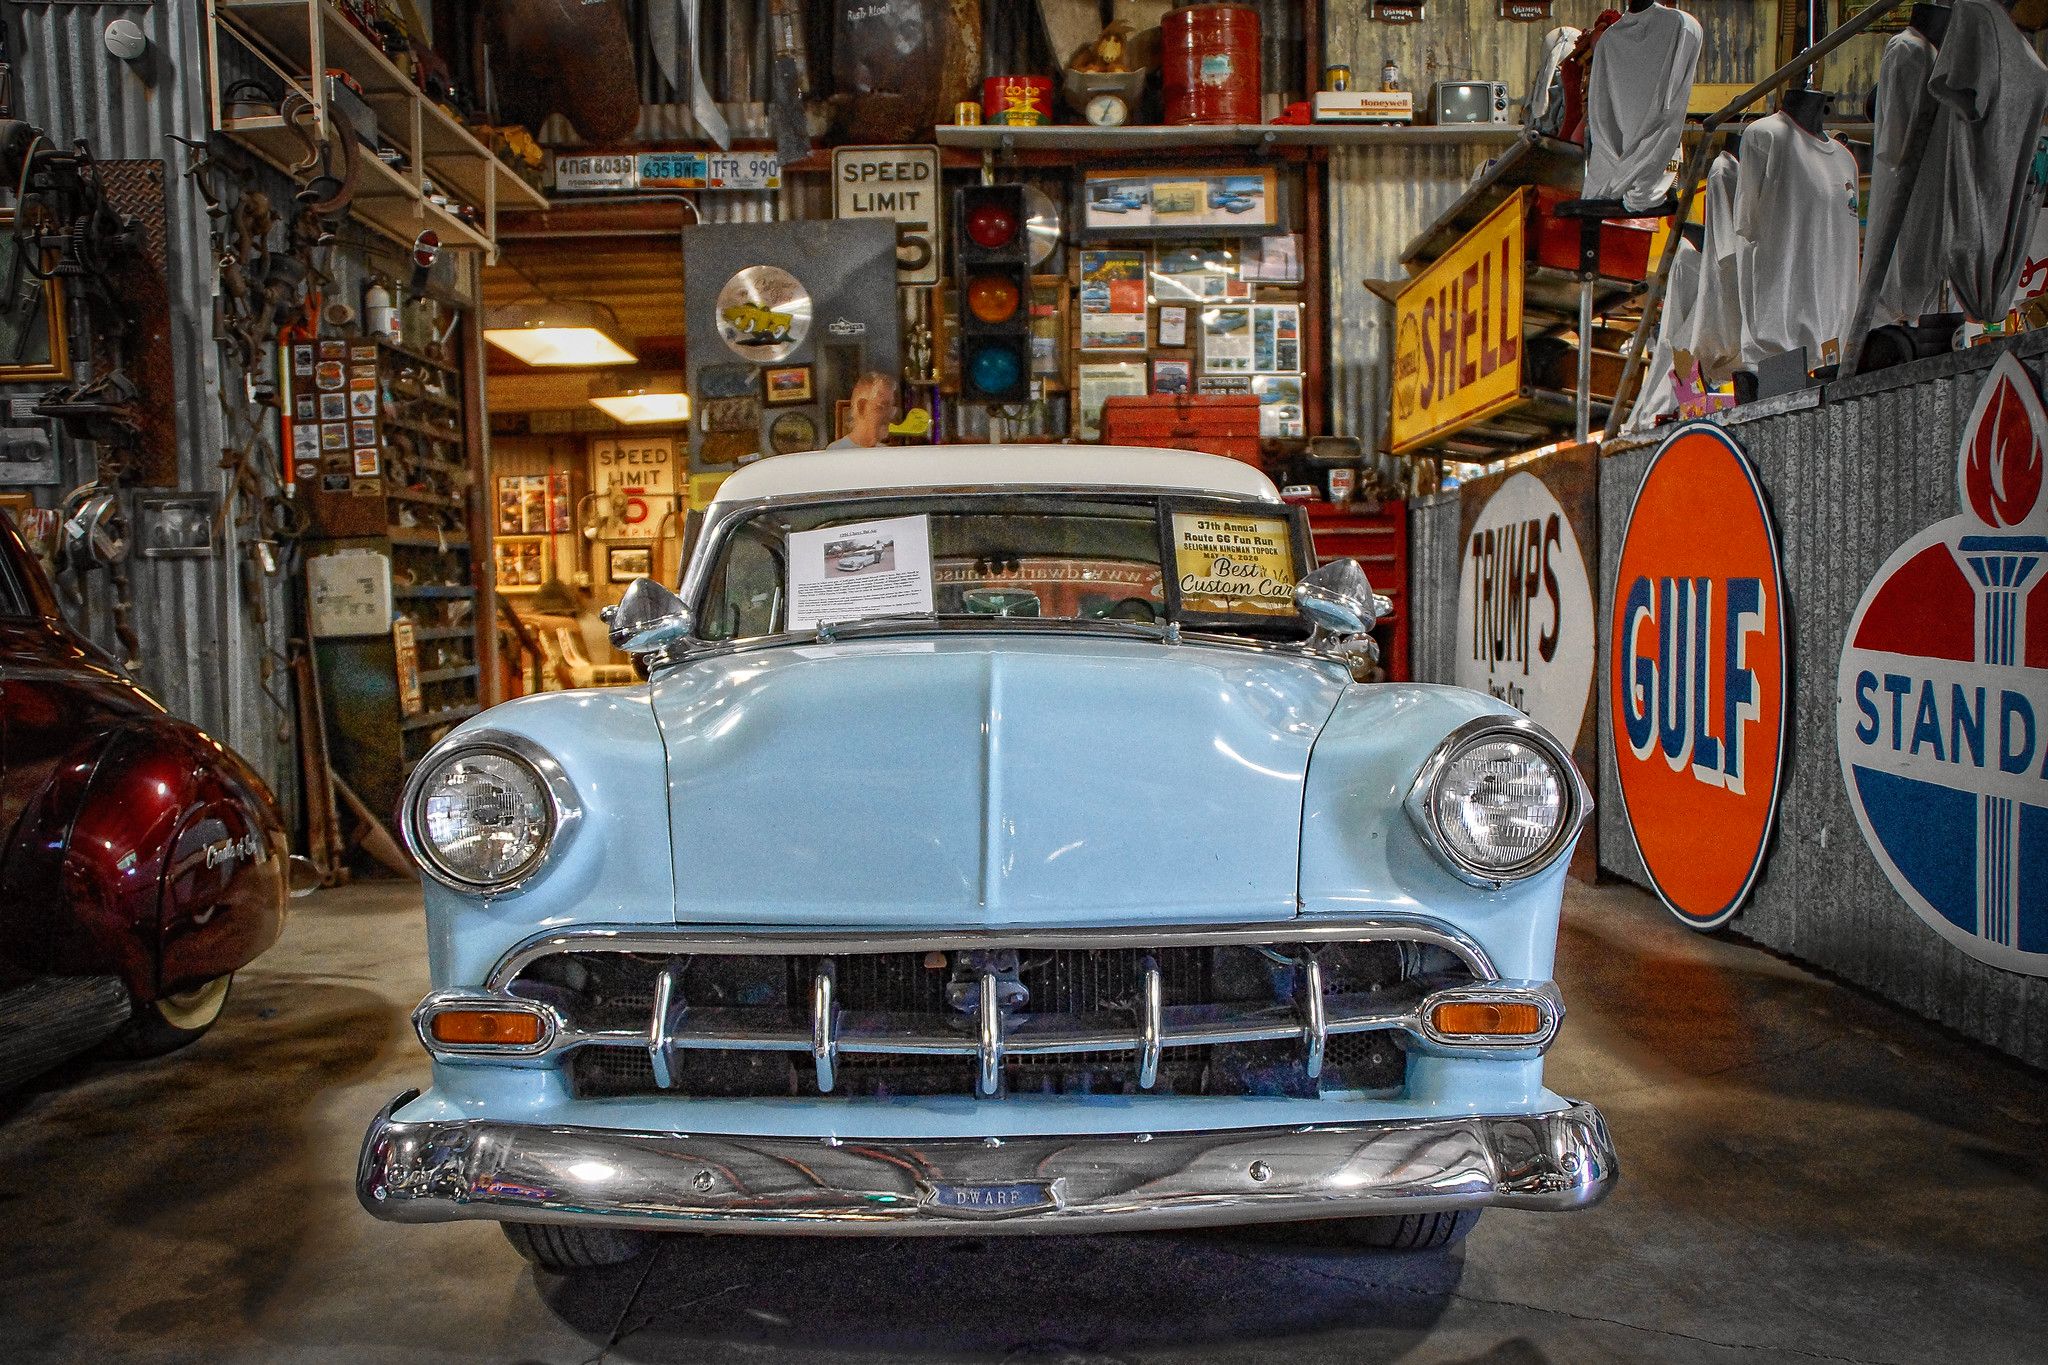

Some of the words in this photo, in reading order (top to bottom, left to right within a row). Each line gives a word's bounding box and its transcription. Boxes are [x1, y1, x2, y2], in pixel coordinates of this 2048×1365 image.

[1005, 86, 1040, 97] CO-OP
[1360, 99, 1408, 108] Honeywell
[643, 160, 670, 179] 635
[749, 160, 777, 178] 990
[843, 161, 930, 182] SPEED
[852, 191, 920, 212] LIMIT
[895, 221, 932, 271] 5
[1420, 235, 1518, 411] SHELL
[600, 448, 668, 466] SPEED
[1197, 521, 1221, 531] 37th
[1223, 522, 1258, 533] Annual
[1184, 532, 1214, 543] Route
[1233, 535, 1252, 545] Fun
[1254, 536, 1274, 546] Run
[1183, 543, 1218, 552] SELIGMAN
[1220, 544, 1251, 554] KINGMAN
[1252, 546, 1279, 556] TOPOCK
[1213, 557, 1259, 578] Best
[1180, 574, 1255, 595] Custom
[1258, 578, 1293, 596] Car
[1472, 511, 1562, 675] TRUMPS
[1621, 576, 1766, 795] GULF
[956, 1190, 1021, 1205] DWARF
